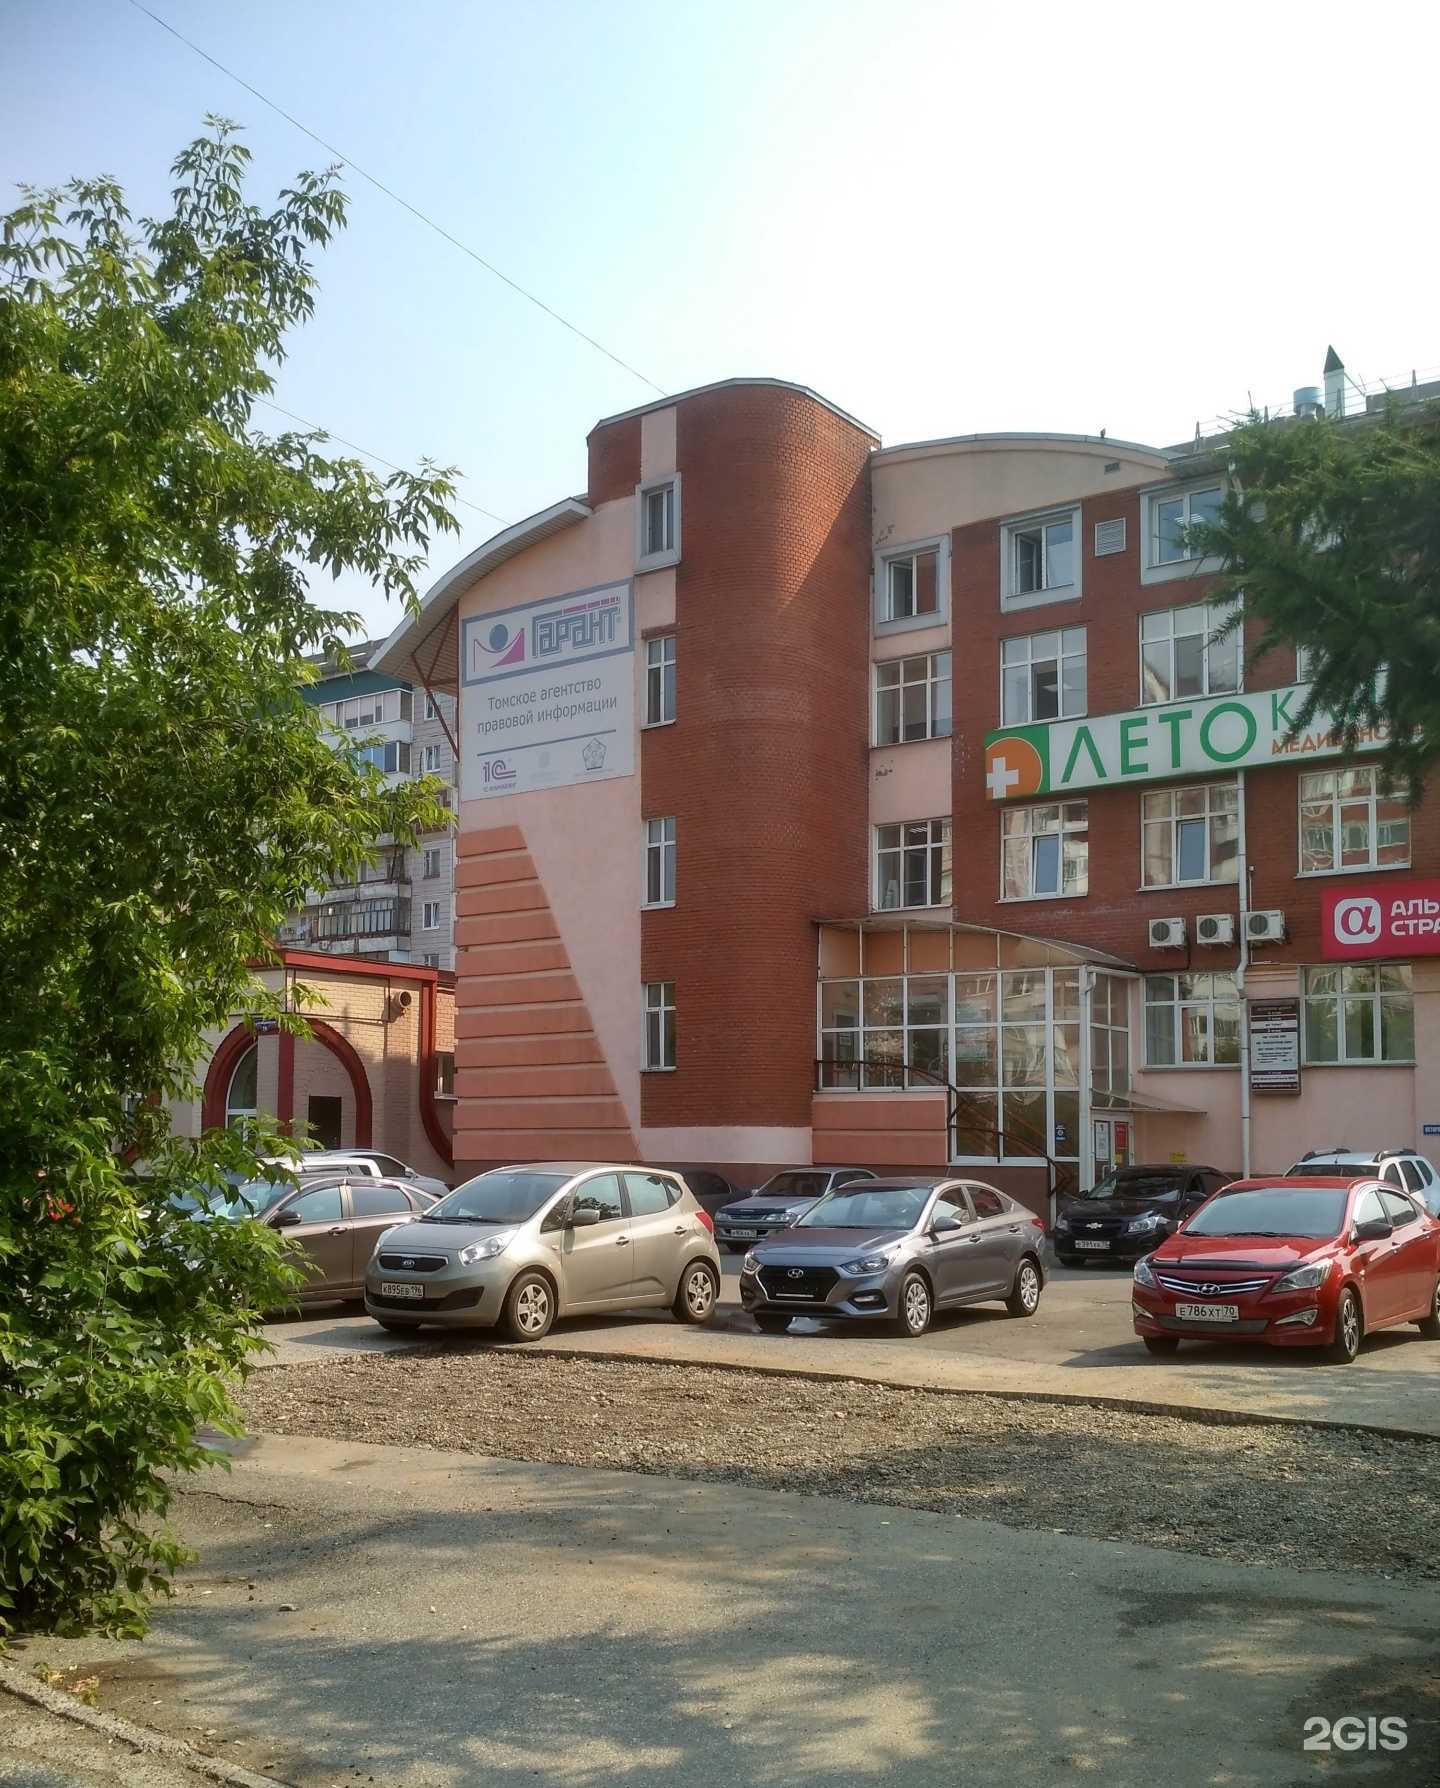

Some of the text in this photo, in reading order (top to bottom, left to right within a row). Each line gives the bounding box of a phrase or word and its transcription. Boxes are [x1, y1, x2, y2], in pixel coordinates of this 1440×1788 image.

[488, 678, 601, 712] Томское агентство
[477, 697, 618, 736] правовой информации
[1061, 702, 1257, 784] ЛЕТО
[1179, 1305, 1235, 1318] Е786ХТ 70
